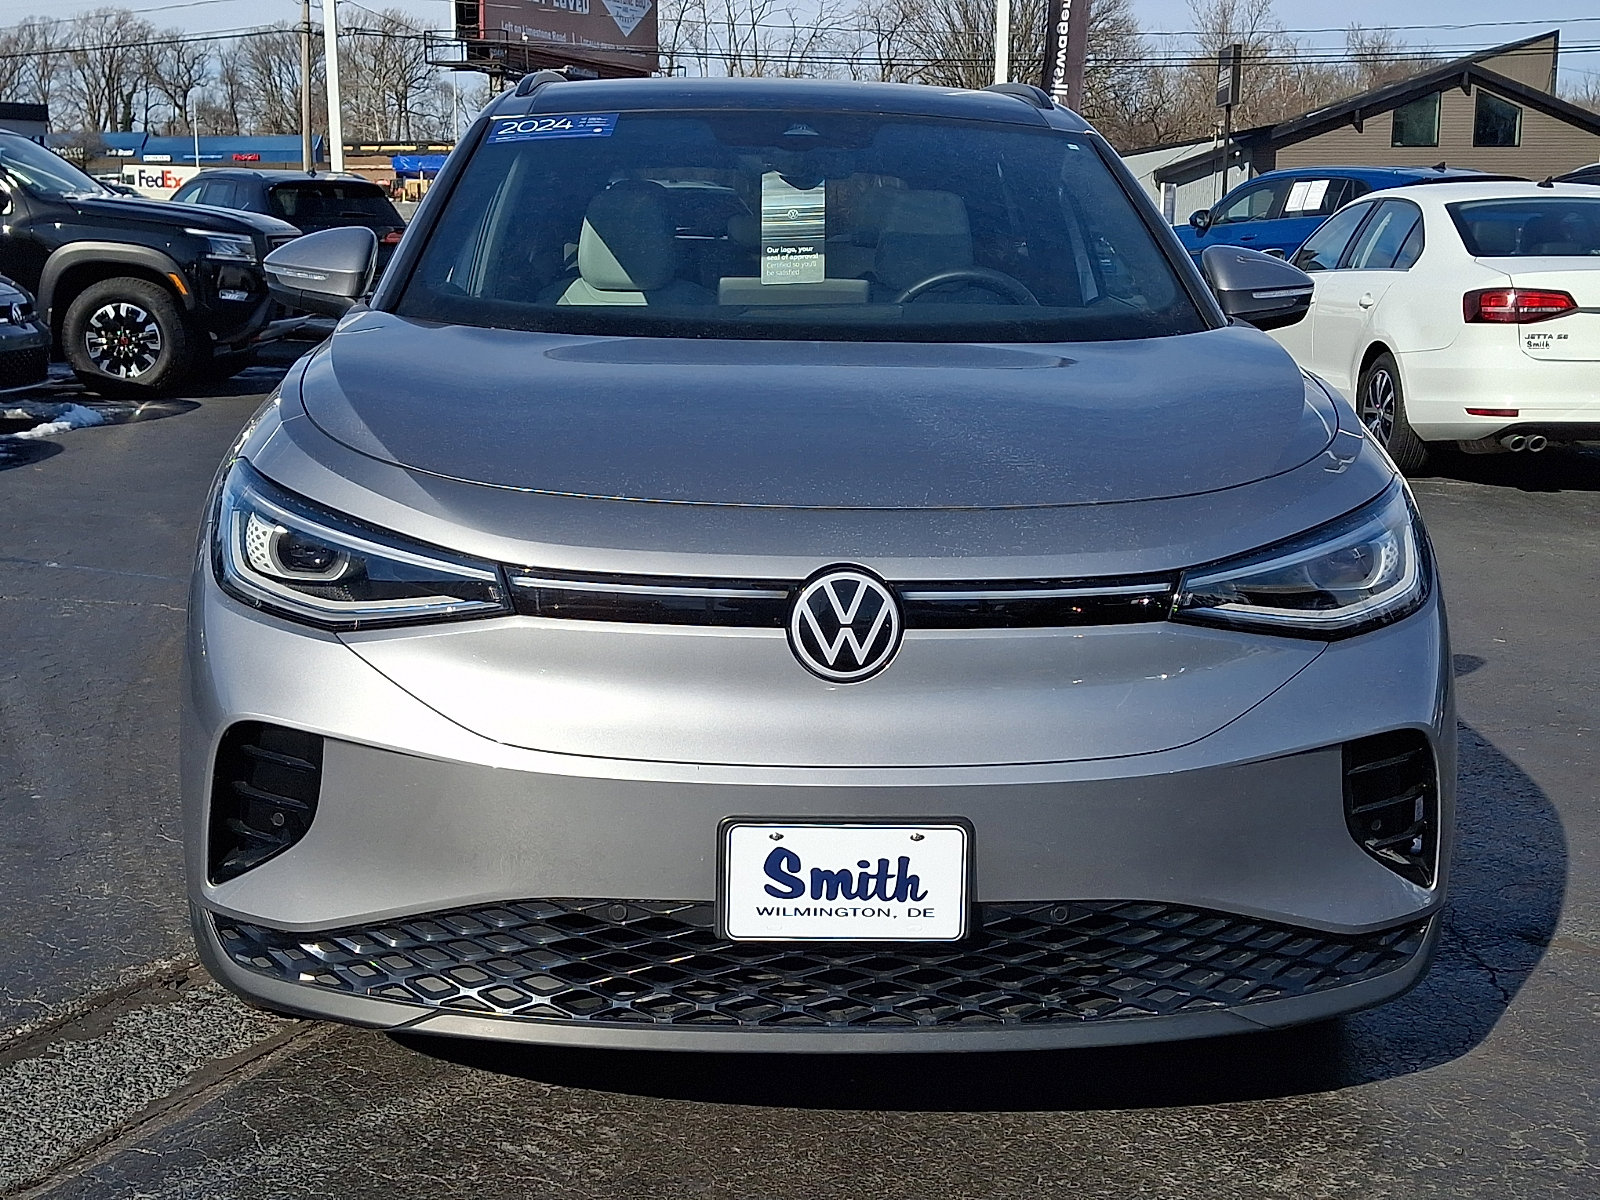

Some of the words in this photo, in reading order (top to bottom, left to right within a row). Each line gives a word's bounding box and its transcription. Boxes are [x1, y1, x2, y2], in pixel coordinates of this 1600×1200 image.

[497, 118, 573, 135] 2024
[138, 169, 183, 188] FedEx
[789, 253, 818, 261] approval
[798, 246, 814, 254] your
[763, 847, 928, 902] Smith
[756, 906, 897, 919] WILMINGTON,
[907, 907, 935, 918] DE
